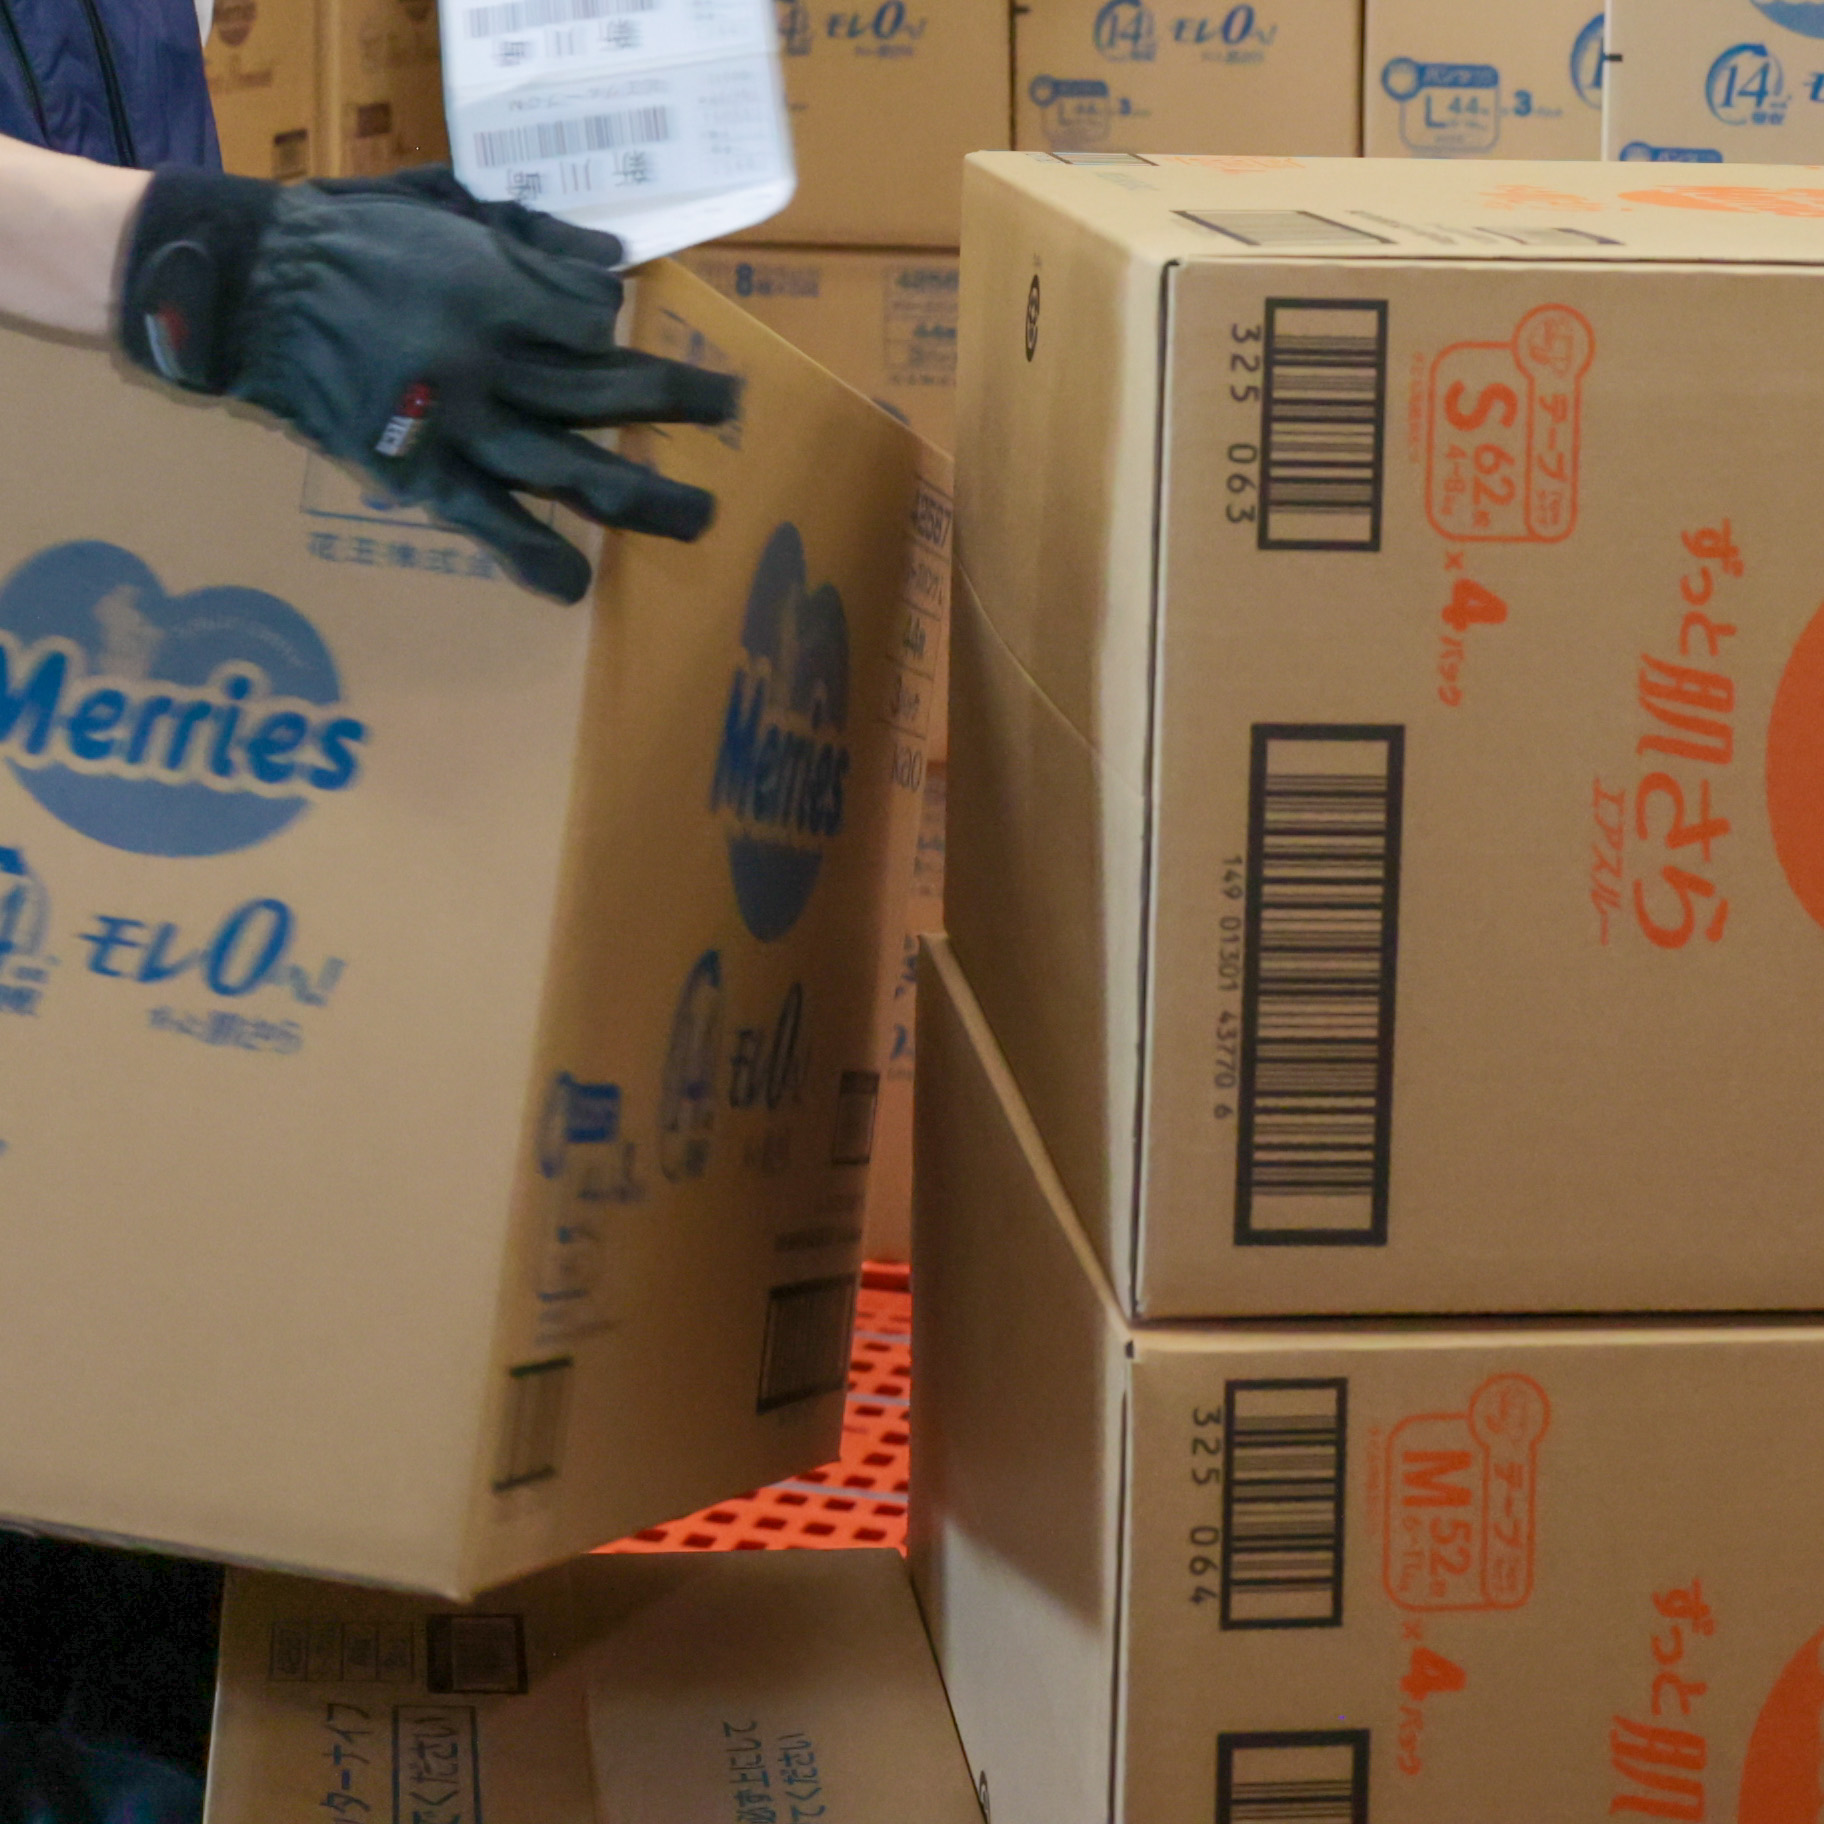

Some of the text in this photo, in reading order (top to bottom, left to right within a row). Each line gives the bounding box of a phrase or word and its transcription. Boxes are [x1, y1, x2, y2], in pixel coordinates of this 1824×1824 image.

[1227, 325, 1261, 524] 325 063
[1445, 380, 1518, 431] S
[1538, 395, 1569, 482] テープ
[1634, 518, 1744, 950] ずっと肌さら
[1213, 856, 1244, 1091] 149 01301 43770
[1190, 1408, 1222, 1604] 325 064
[1402, 1451, 1472, 1507] M
[318, 1703, 374, 1824] ターナイフ
